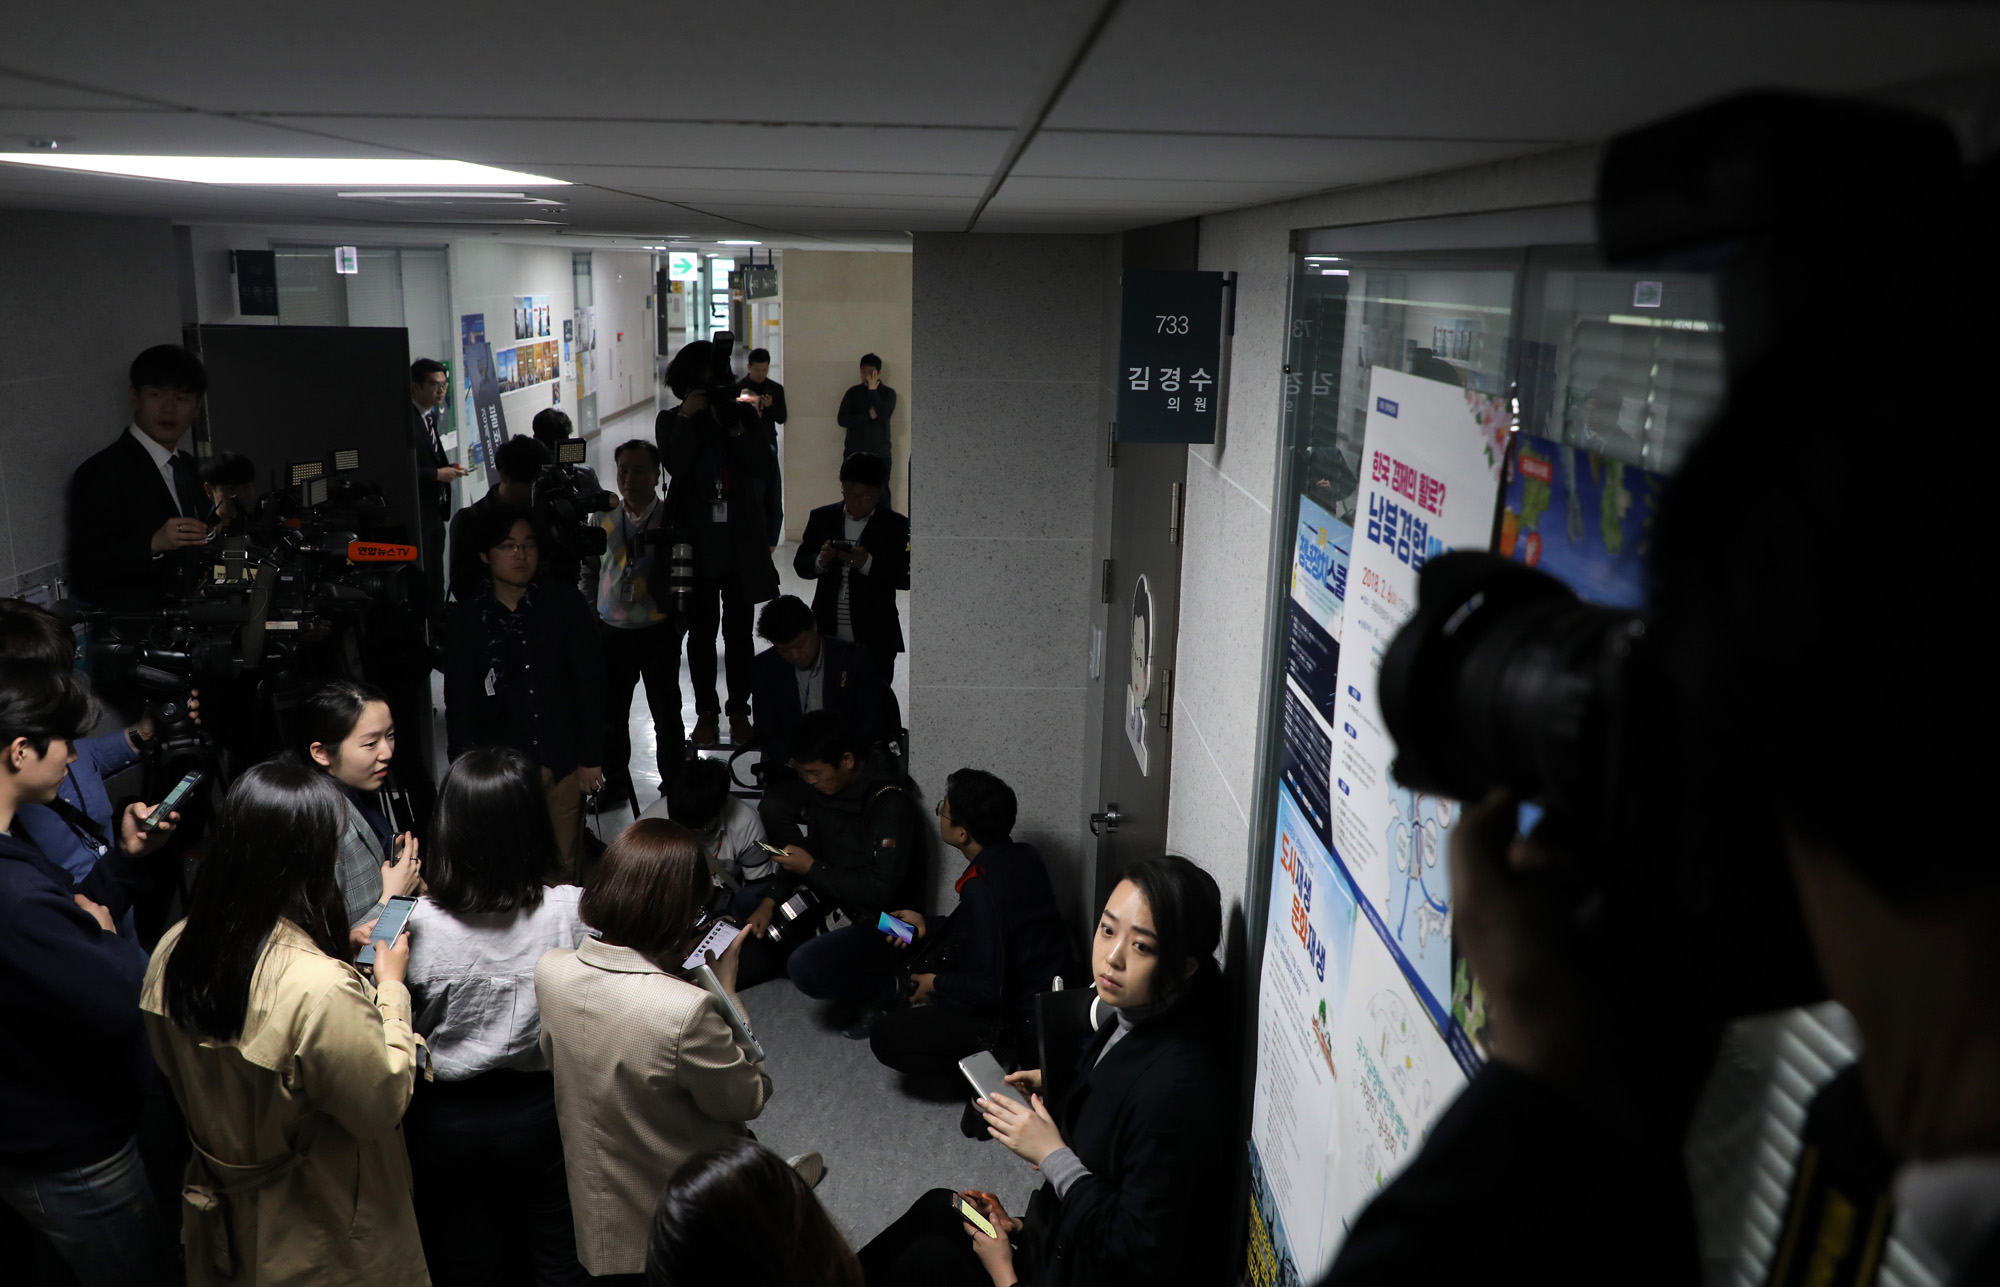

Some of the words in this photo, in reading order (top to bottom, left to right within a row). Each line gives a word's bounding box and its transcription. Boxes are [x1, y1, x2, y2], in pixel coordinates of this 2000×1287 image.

[1155, 315, 1189, 334] 733
[1372, 450, 1391, 487] 한국
[1391, 459, 1418, 502] 경제의
[1418, 473, 1446, 518] 활로?
[358, 546, 409, 556] 연합뉴스TV
[1299, 535, 1347, 602] 청년정치스쿨
[1281, 832, 1312, 913] 도시재생
[1292, 893, 1326, 983] 문화재생
